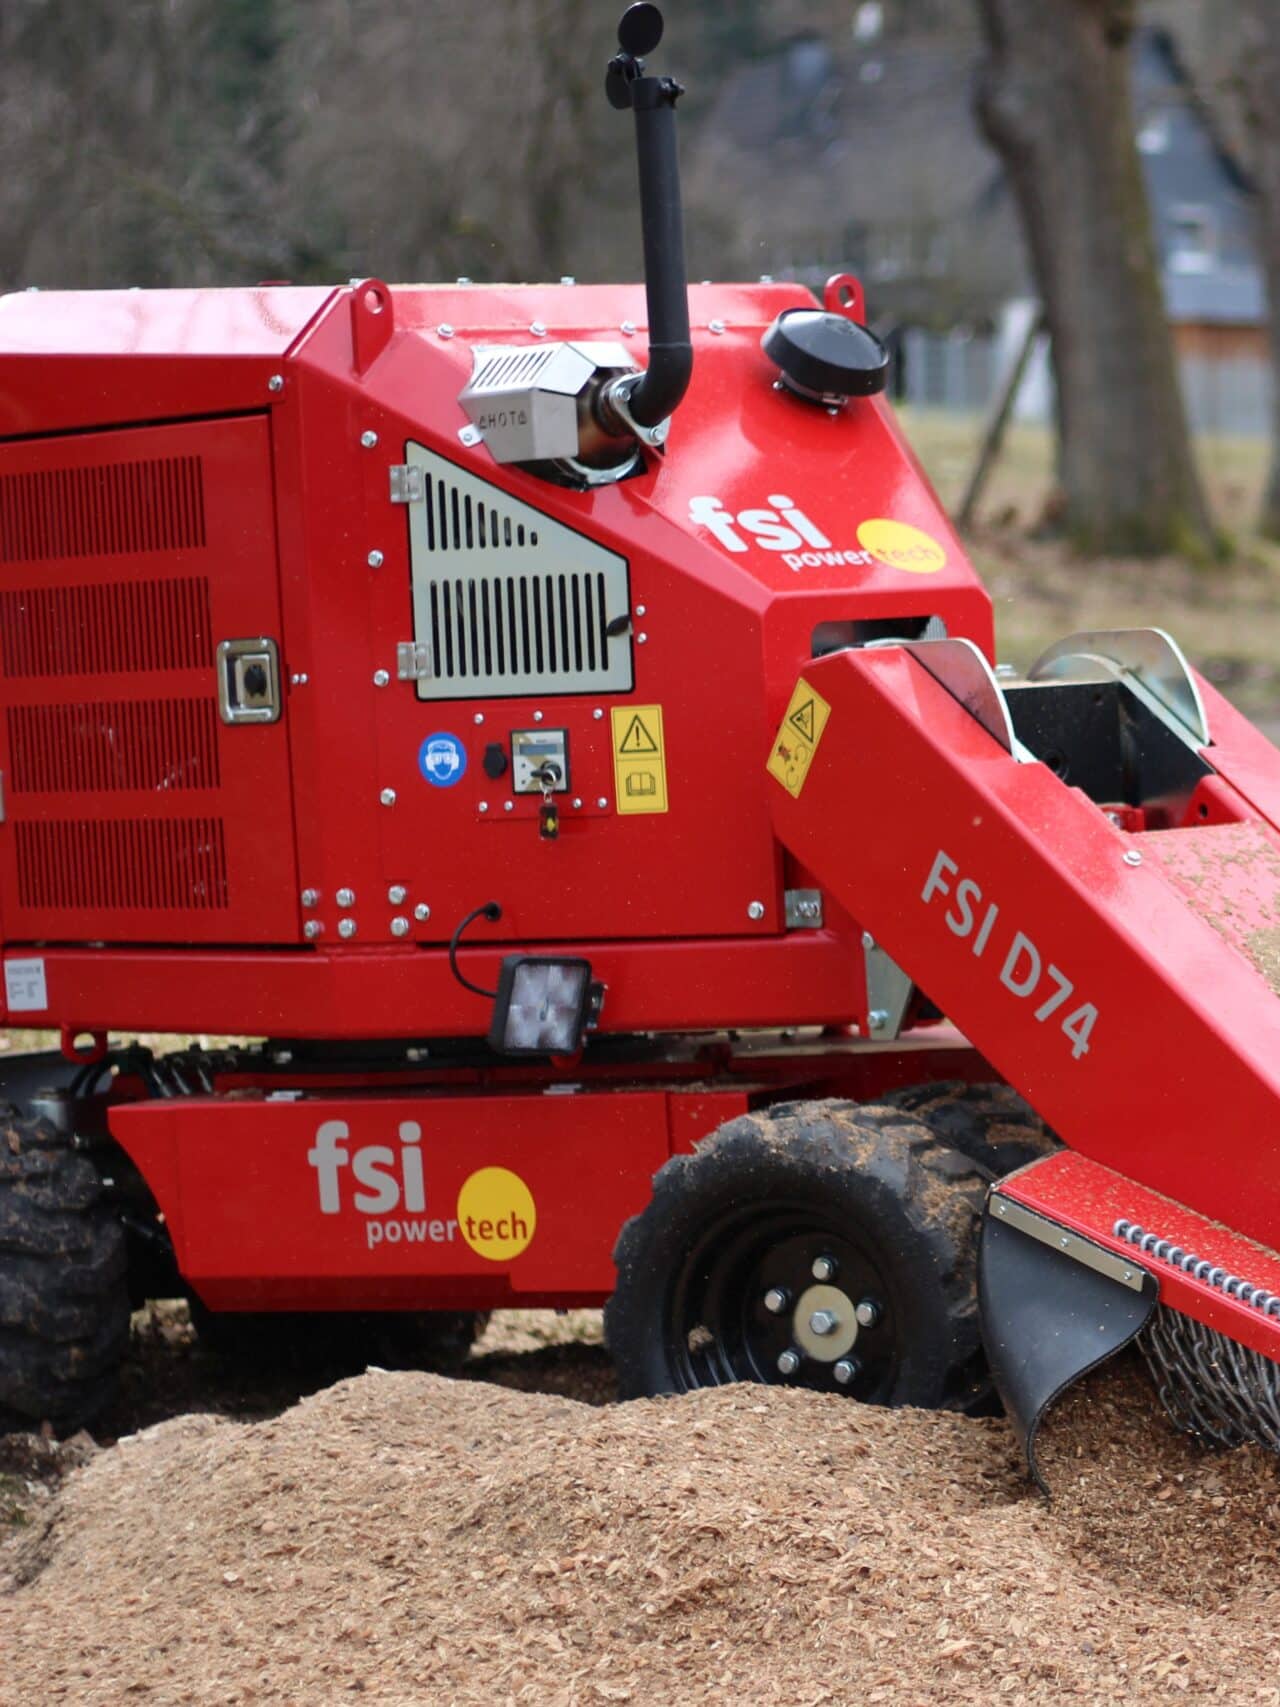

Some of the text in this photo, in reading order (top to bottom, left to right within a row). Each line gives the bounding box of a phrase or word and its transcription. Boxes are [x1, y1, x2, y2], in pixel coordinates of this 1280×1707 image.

[488, 411, 517, 429] HOT
[688, 494, 832, 552] fsi
[781, 550, 873, 572] power
[921, 849, 1098, 1059] FSI D74
[307, 1120, 426, 1214] fsi
[366, 1211, 527, 1249] power tech
